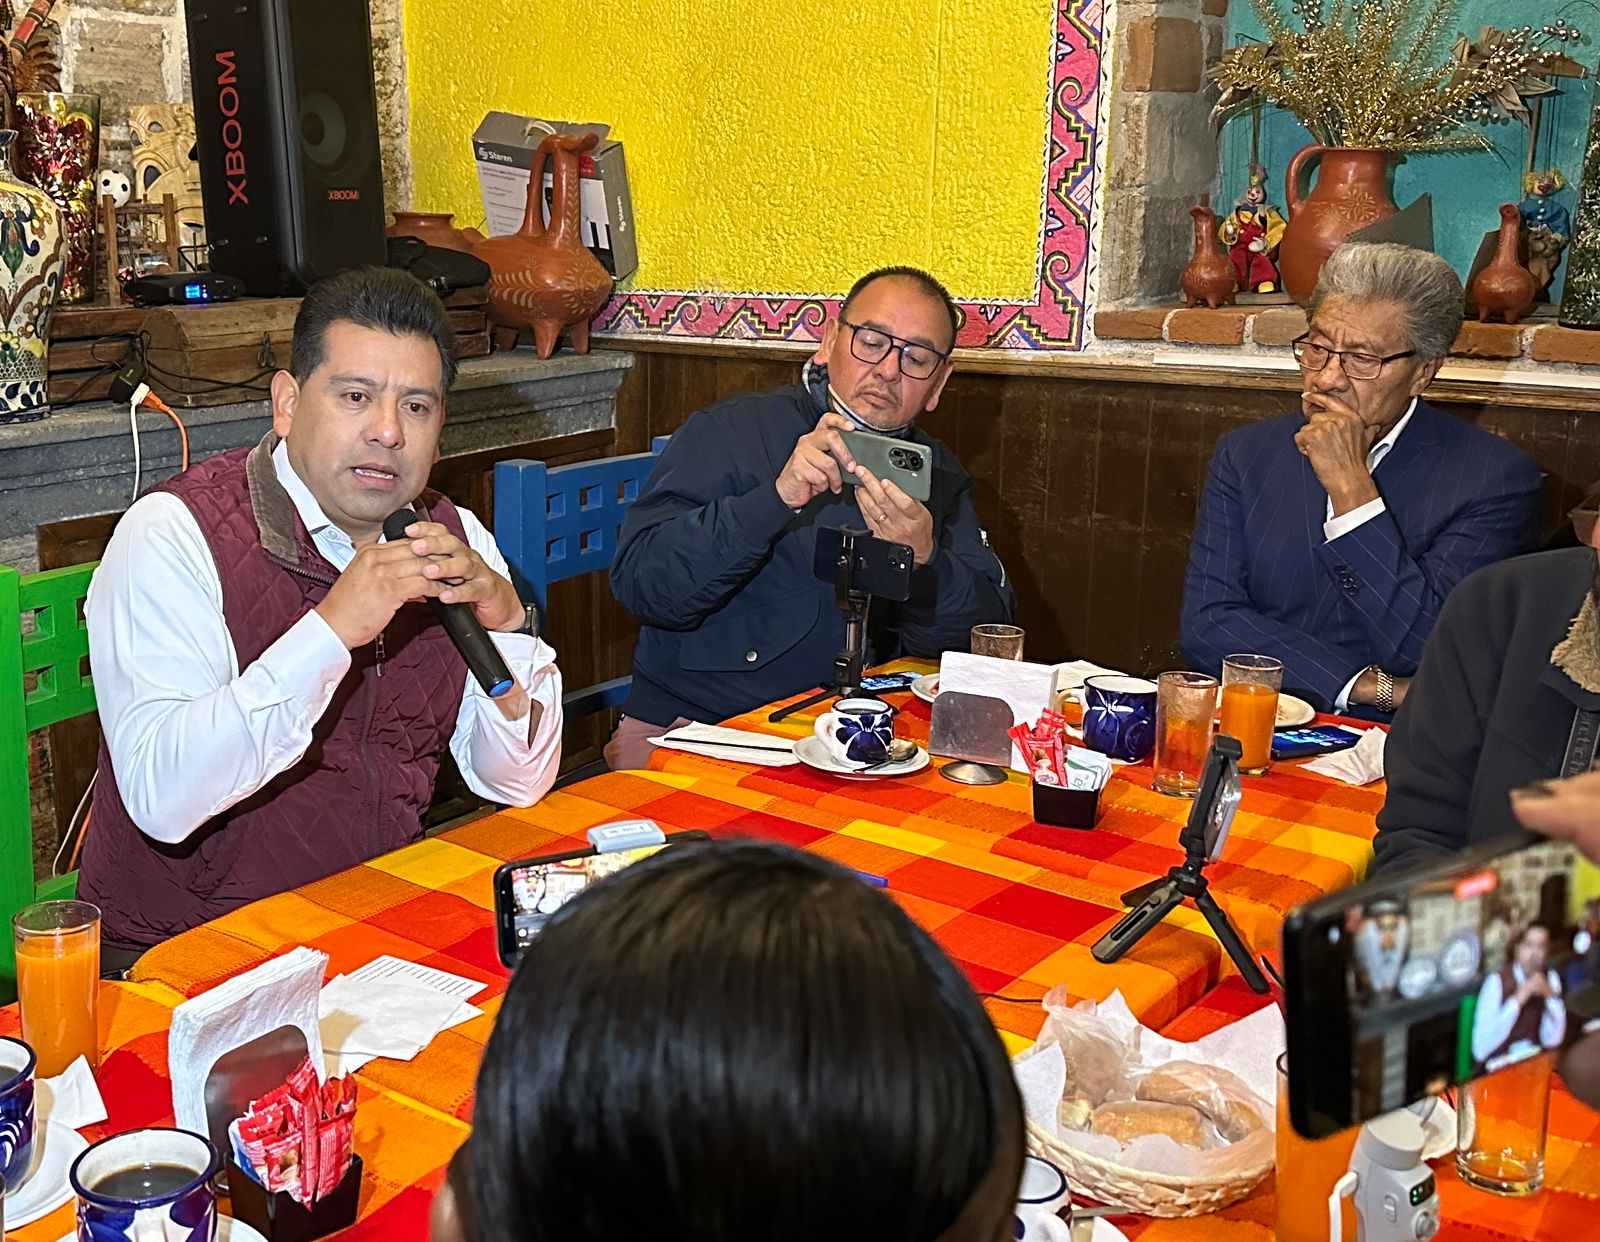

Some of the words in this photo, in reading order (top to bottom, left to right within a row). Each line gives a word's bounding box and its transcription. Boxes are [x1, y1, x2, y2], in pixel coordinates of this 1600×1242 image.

[215, 50, 249, 206] XBOOM
[488, 150, 513, 163] Steren
[328, 189, 359, 201] XBOOM
[616, 195, 624, 222] Steren
